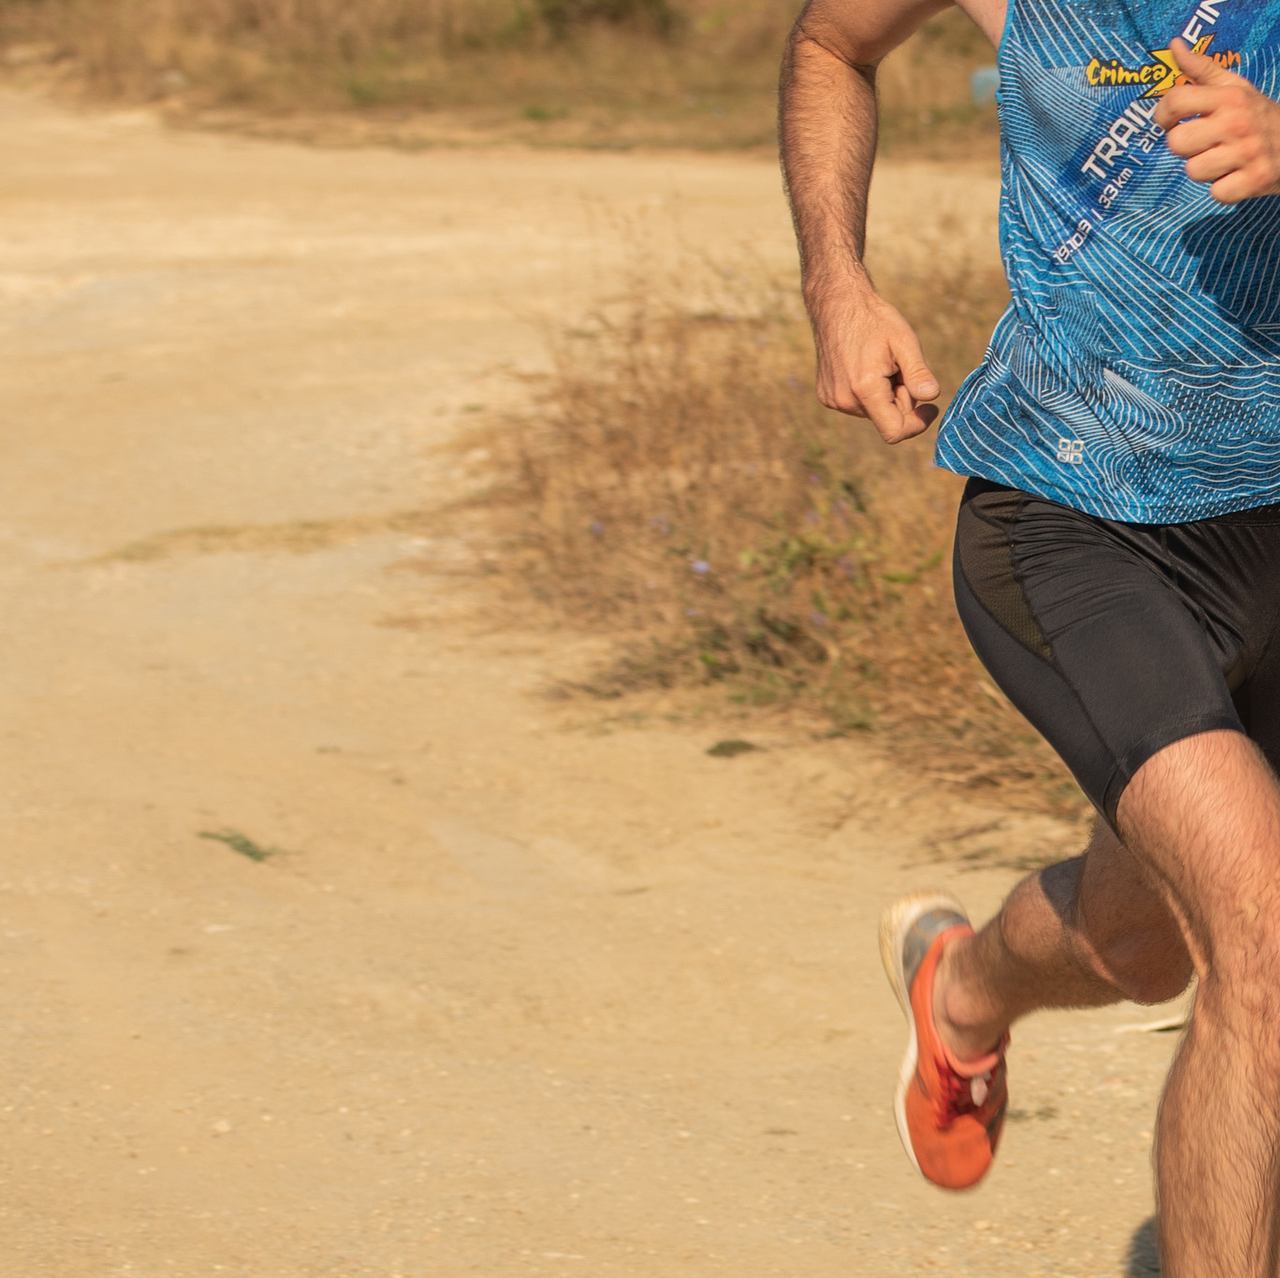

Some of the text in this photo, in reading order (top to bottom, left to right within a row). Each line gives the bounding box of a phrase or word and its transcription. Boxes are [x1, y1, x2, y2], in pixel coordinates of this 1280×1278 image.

[1086, 58, 1167, 85] Crimea
[1081, 102, 1159, 180] TRAIL
[1112, 167, 1134, 189] km
